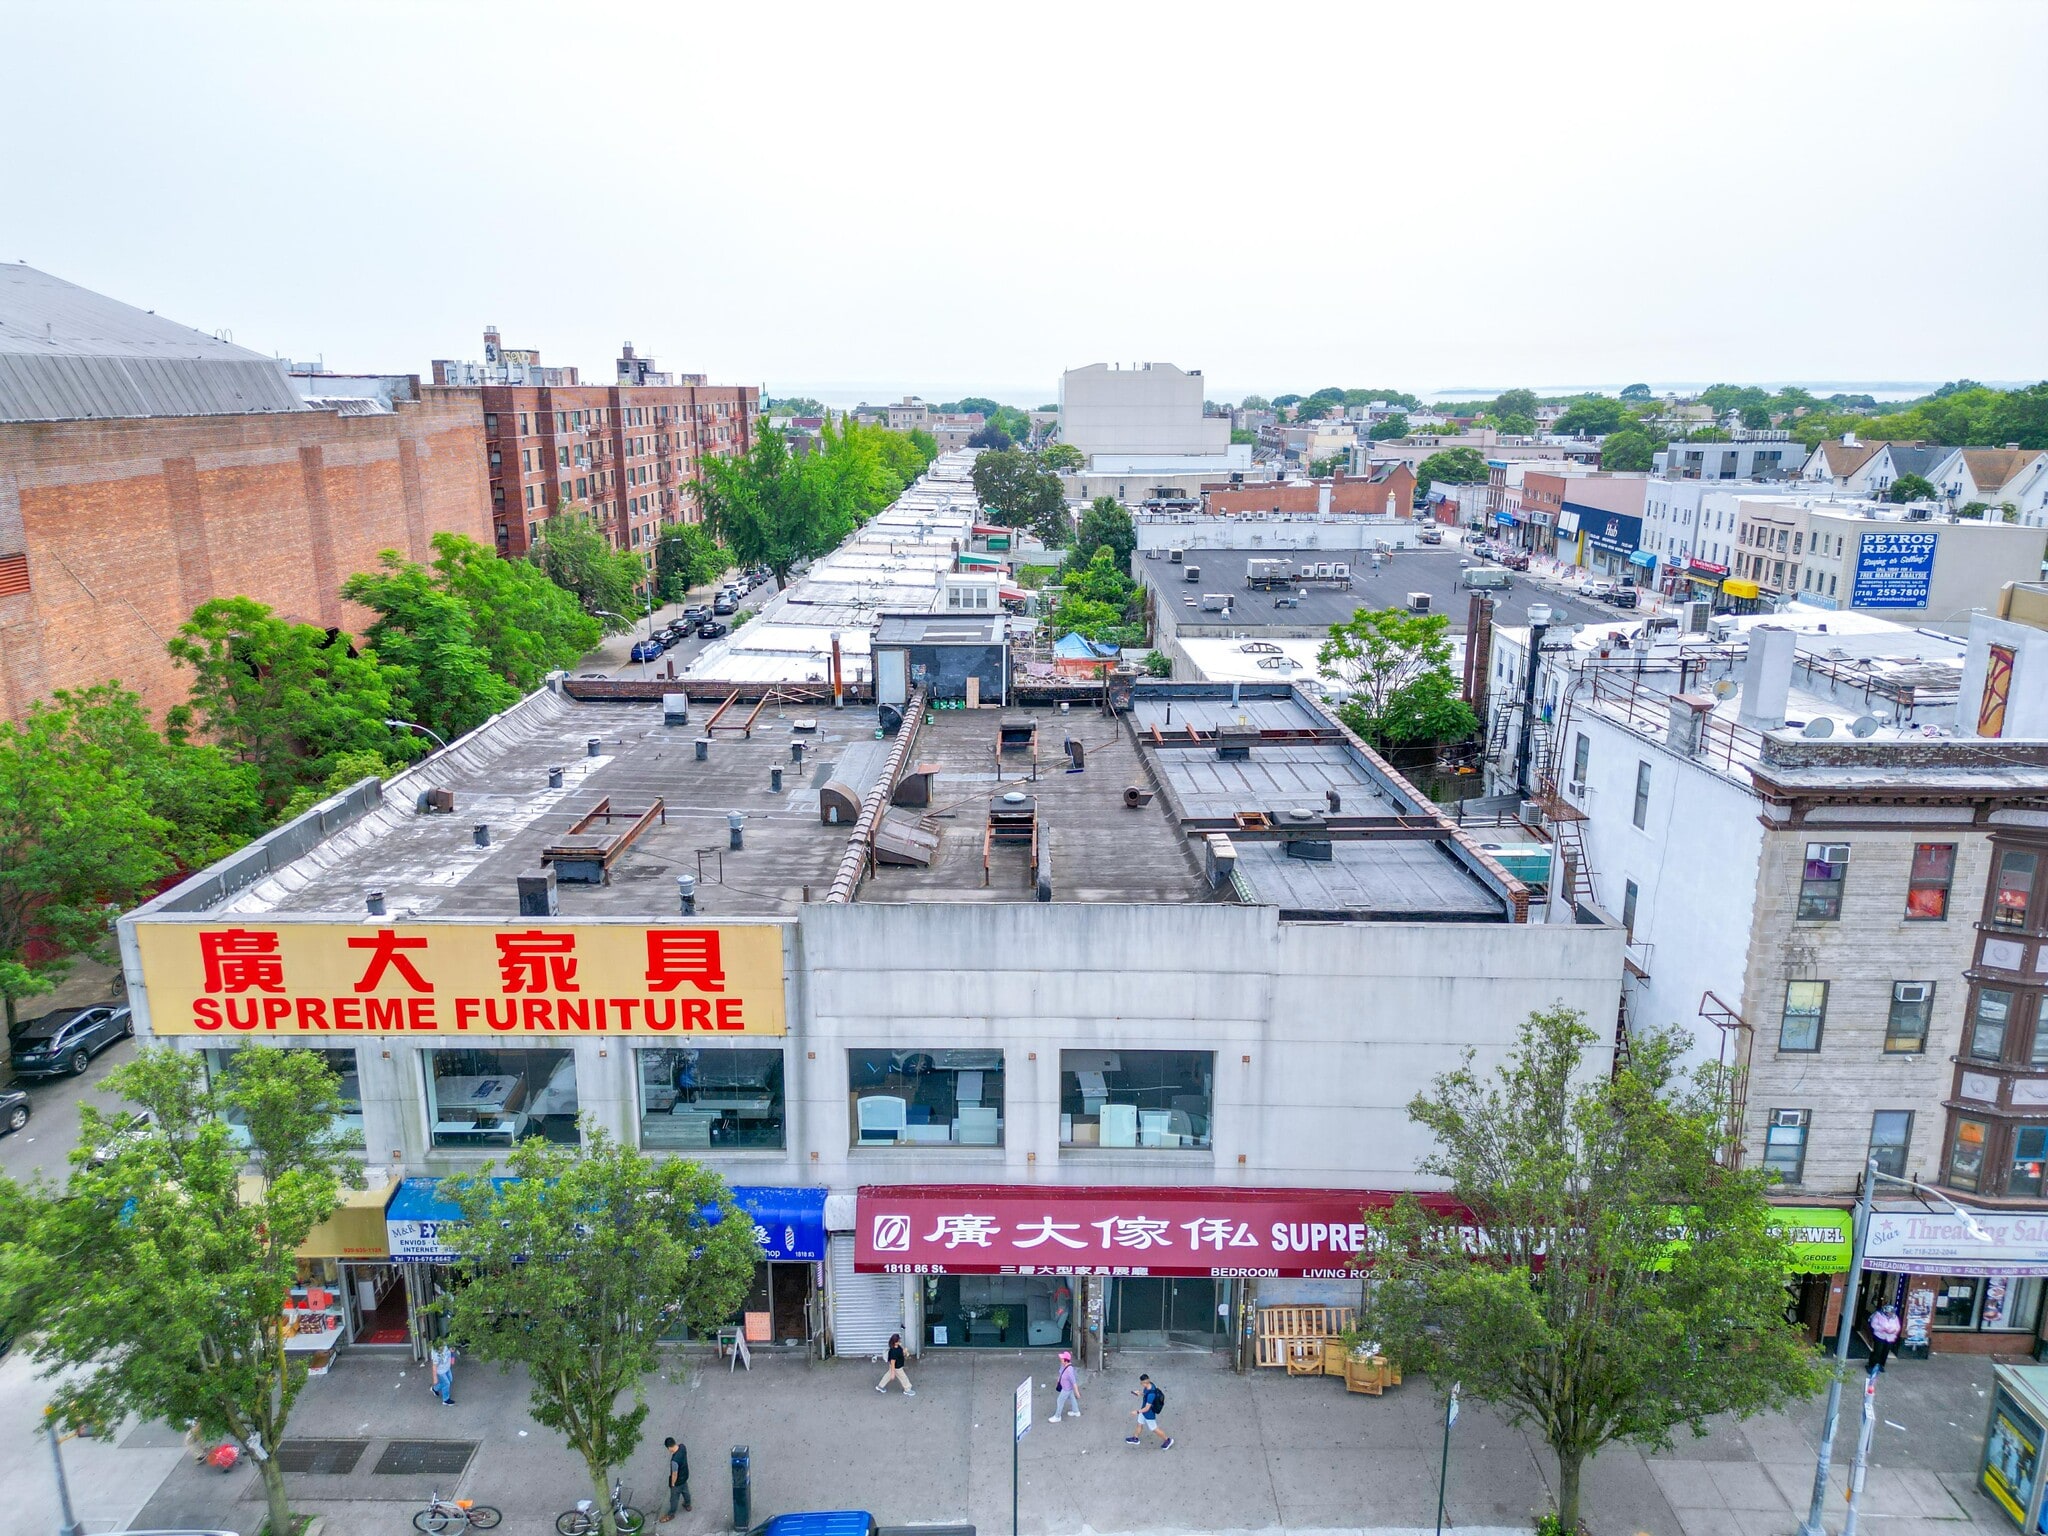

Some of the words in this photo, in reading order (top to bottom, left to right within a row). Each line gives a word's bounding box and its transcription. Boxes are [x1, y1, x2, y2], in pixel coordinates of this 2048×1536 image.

[1863, 534, 1935, 544] PETROS
[1861, 544, 1934, 554] REALTY
[1877, 588, 1927, 597] 259-7800
[199, 929, 725, 993] 廣大家具
[192, 997, 438, 1030] SUPREME
[456, 997, 745, 1031] FURNITURE
[391, 1224, 416, 1238] M&R
[923, 1213, 1260, 1251] 廣大傢俬
[1788, 1227, 1845, 1246] JEWEL
[1872, 1228, 1900, 1246] Star
[1803, 1254, 1837, 1262] GEODES
[883, 1264, 912, 1273] 1818
[914, 1265, 930, 1273] 86
[931, 1265, 947, 1274] St.
[1211, 1267, 1279, 1278] BEDROOM
[1303, 1268, 1347, 1279] LIVING
[1868, 1260, 1910, 1271] THREADING
[1923, 1265, 1952, 1274] WAXING
[1964, 1267, 1988, 1275] FACIAL
